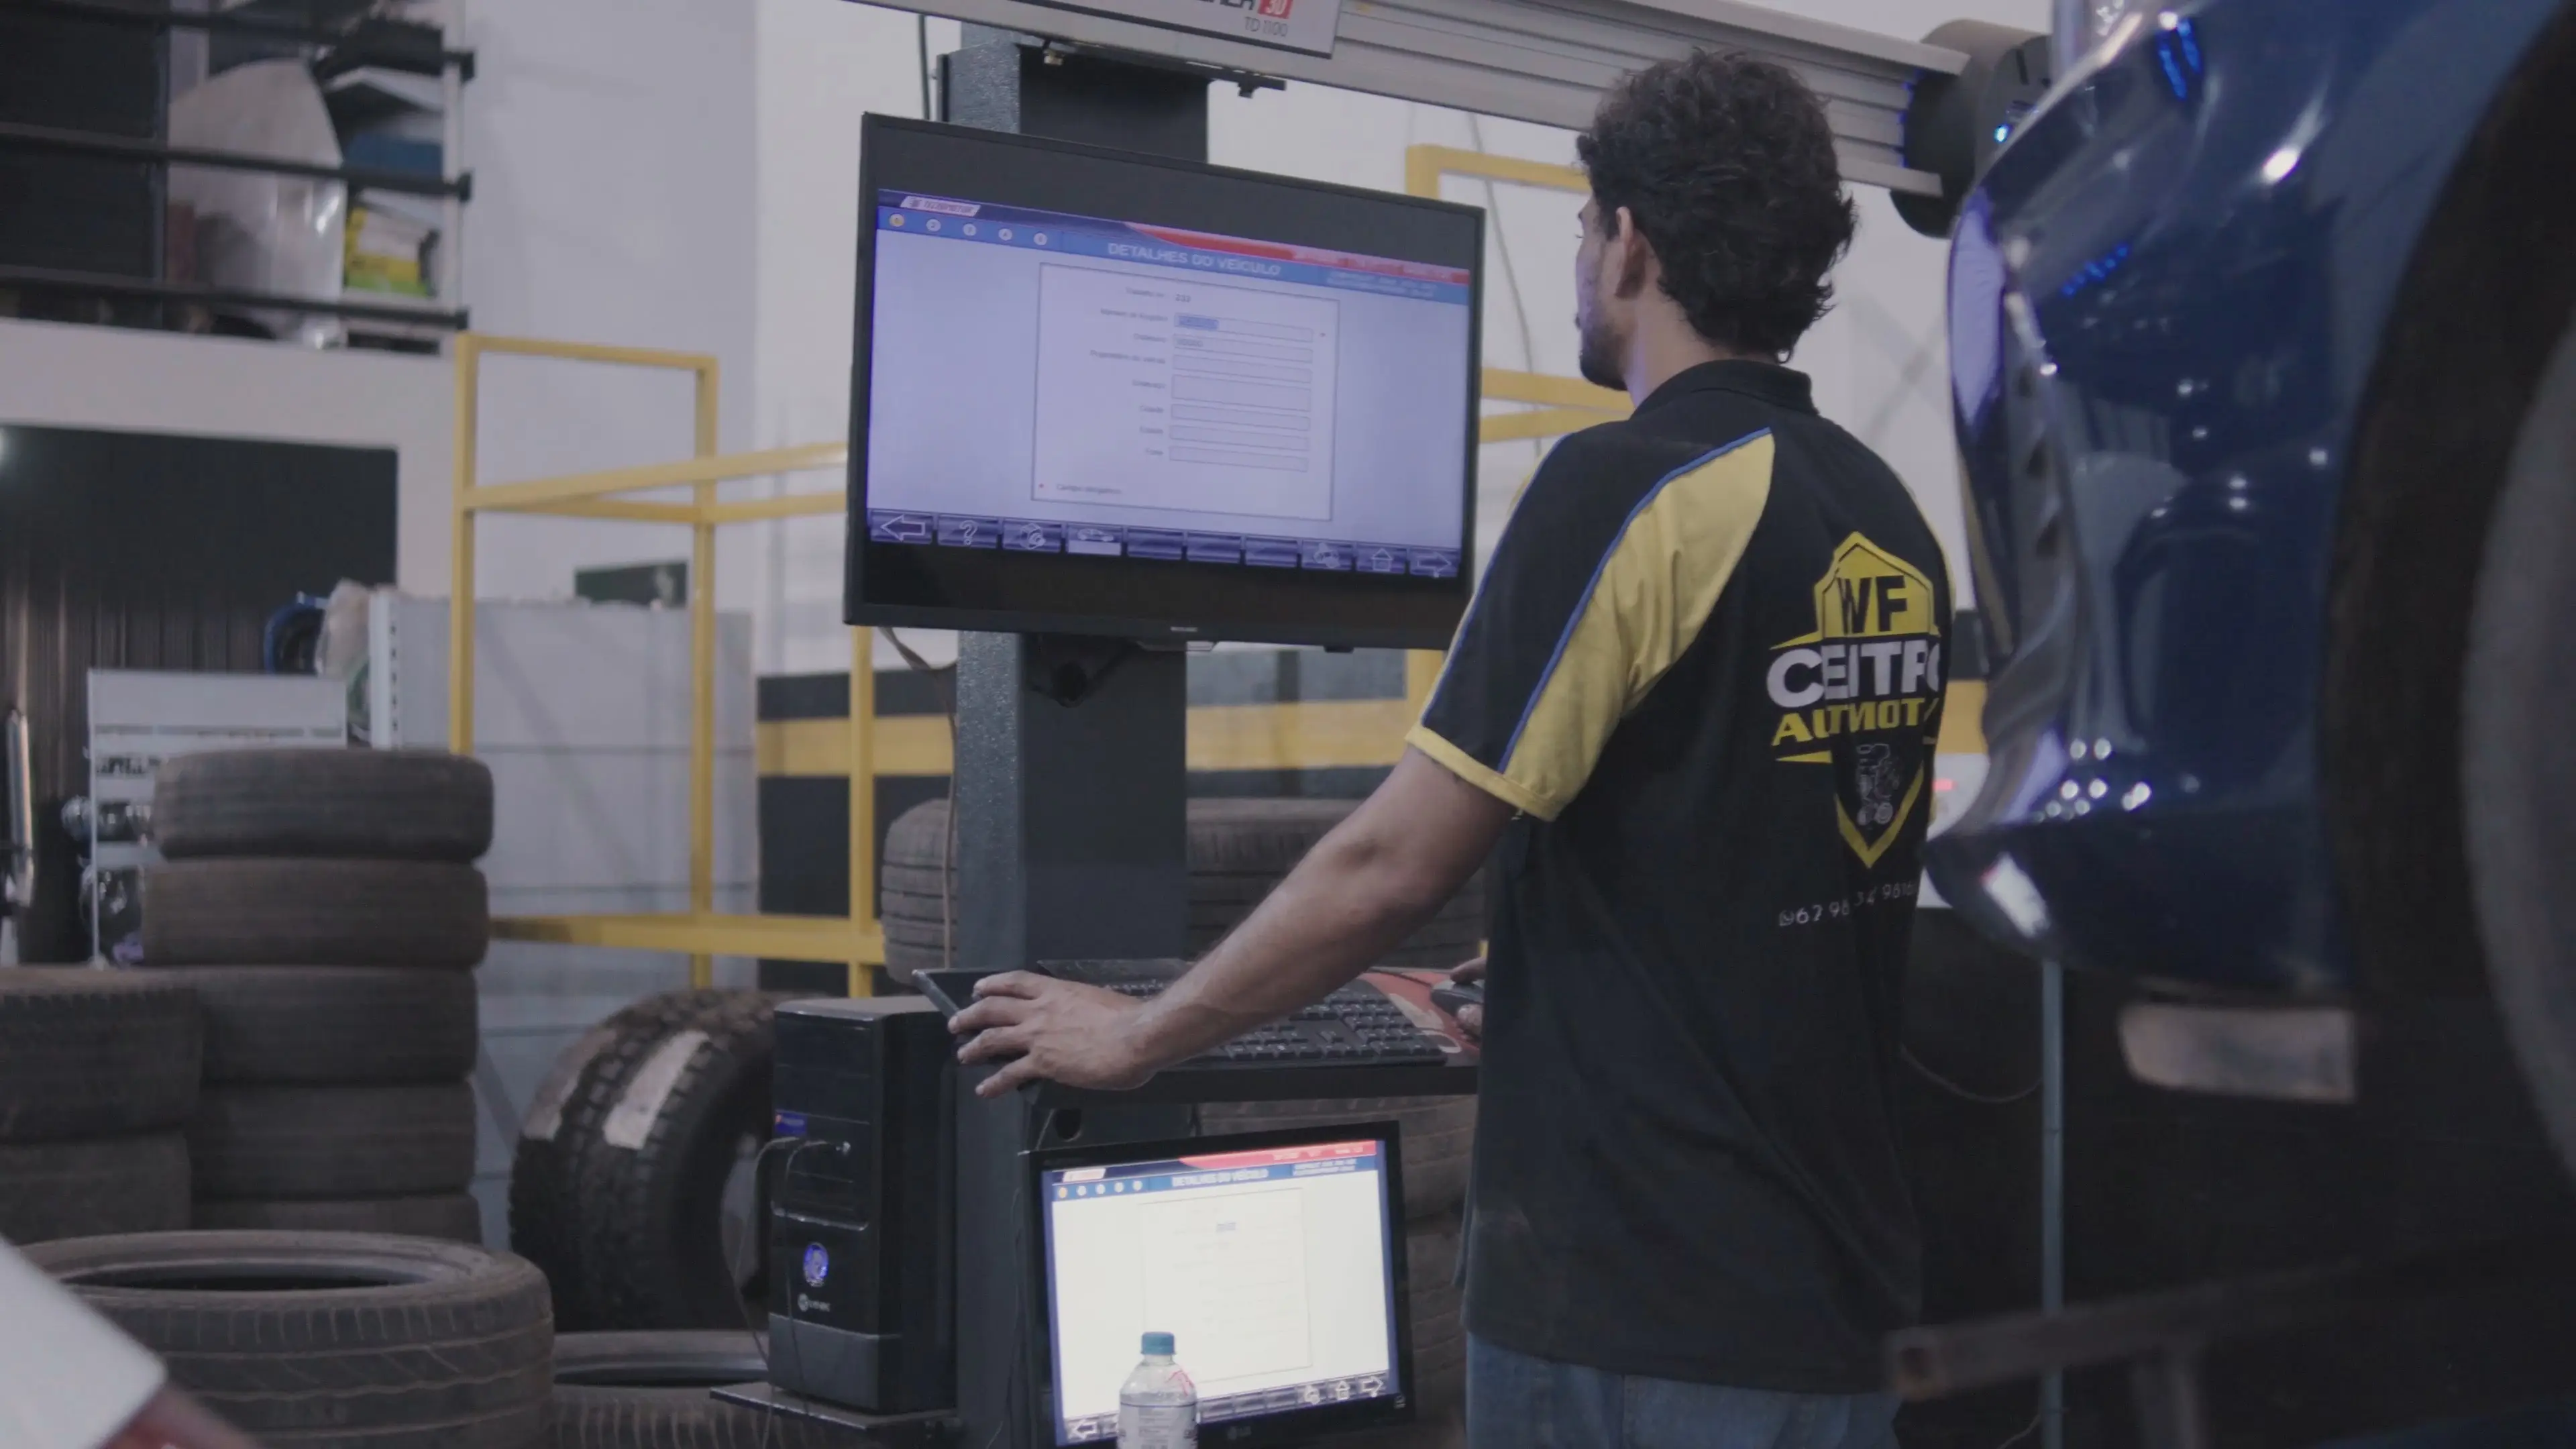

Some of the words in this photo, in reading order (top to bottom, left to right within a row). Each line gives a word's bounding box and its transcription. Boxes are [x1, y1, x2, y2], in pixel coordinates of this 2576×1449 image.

[1244, 16, 1261, 32] TD
[1108, 243, 1188, 264] DETALHES
[1191, 254, 1212, 266] DO
[1837, 574, 1909, 635] WF
